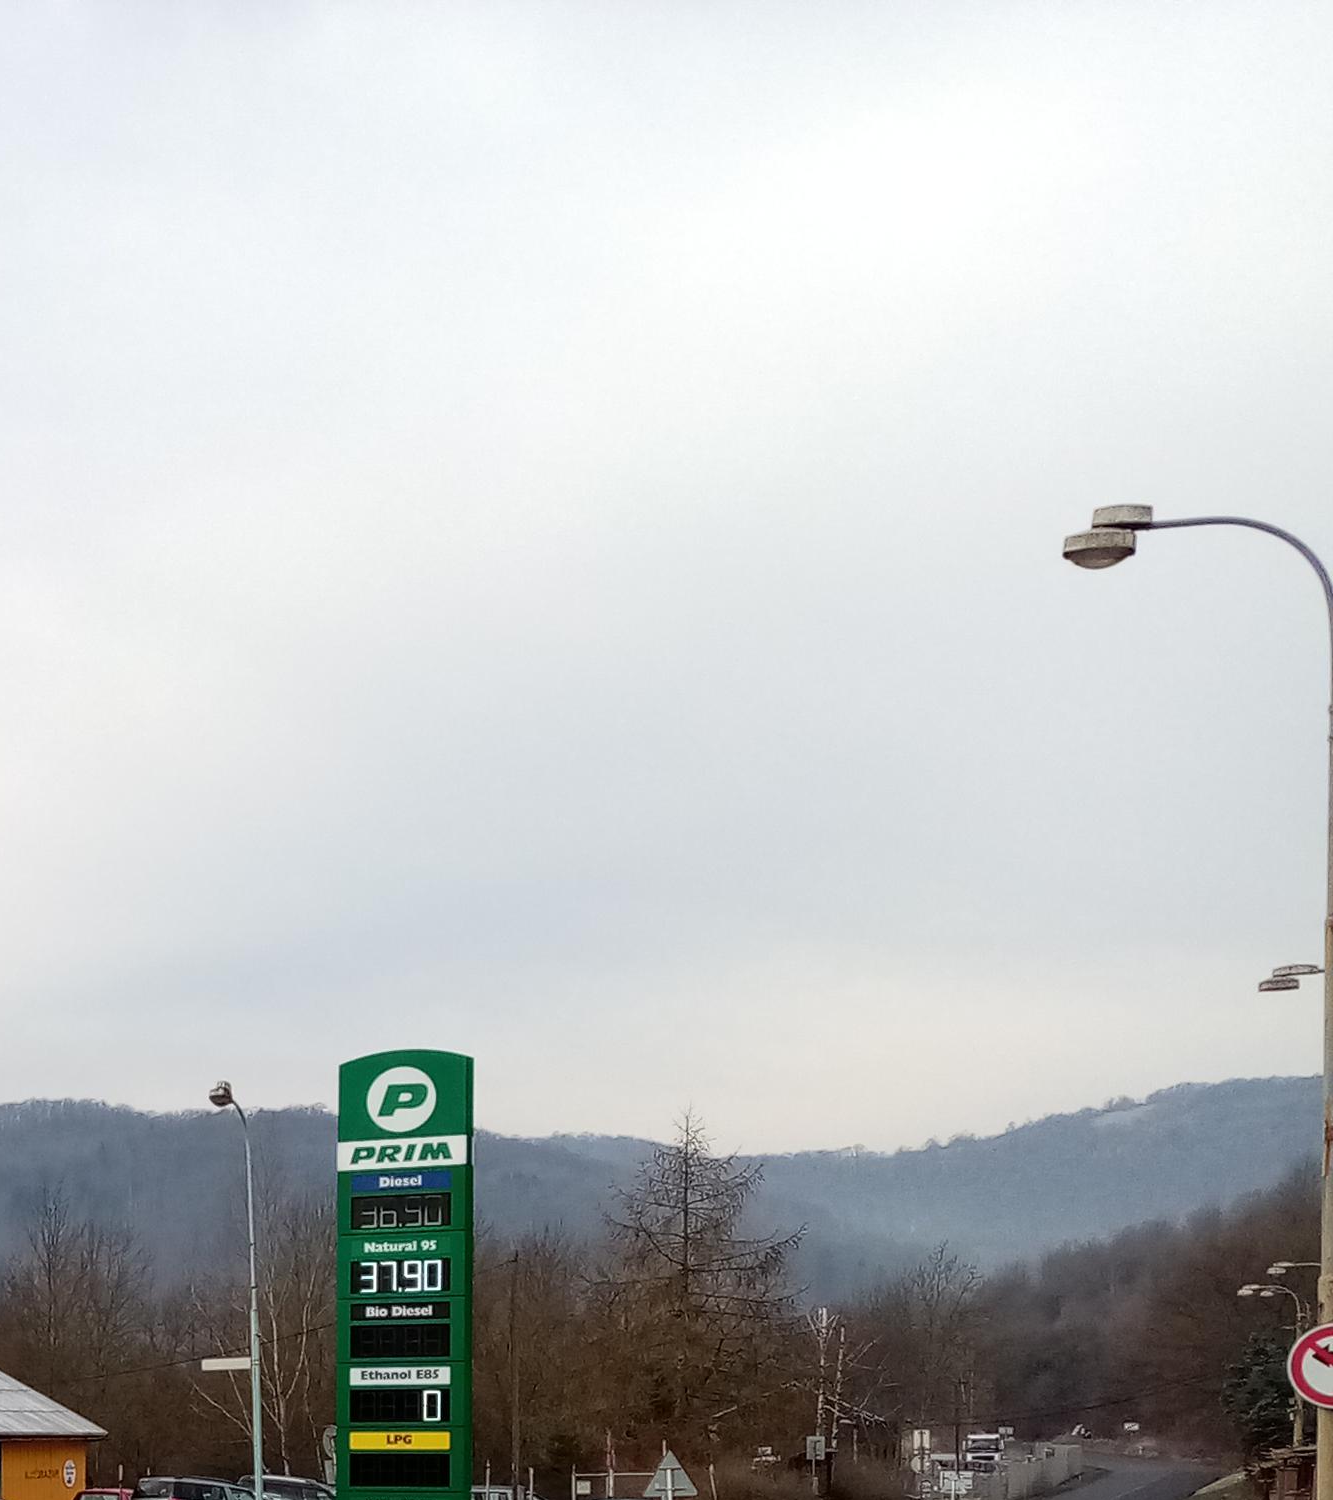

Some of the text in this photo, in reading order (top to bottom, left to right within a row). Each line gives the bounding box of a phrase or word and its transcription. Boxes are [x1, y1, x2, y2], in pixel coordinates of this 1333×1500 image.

[377, 1083, 429, 1117] P
[350, 1142, 453, 1165] PRIM
[379, 1175, 422, 1188] Diesel
[363, 1240, 437, 1253] Natural 95
[360, 1260, 442, 1293] 37.90
[365, 1304, 433, 1318] Bio Diesel
[360, 1369, 440, 1381] Ethanol E85
[386, 1434, 412, 1445] LPG
